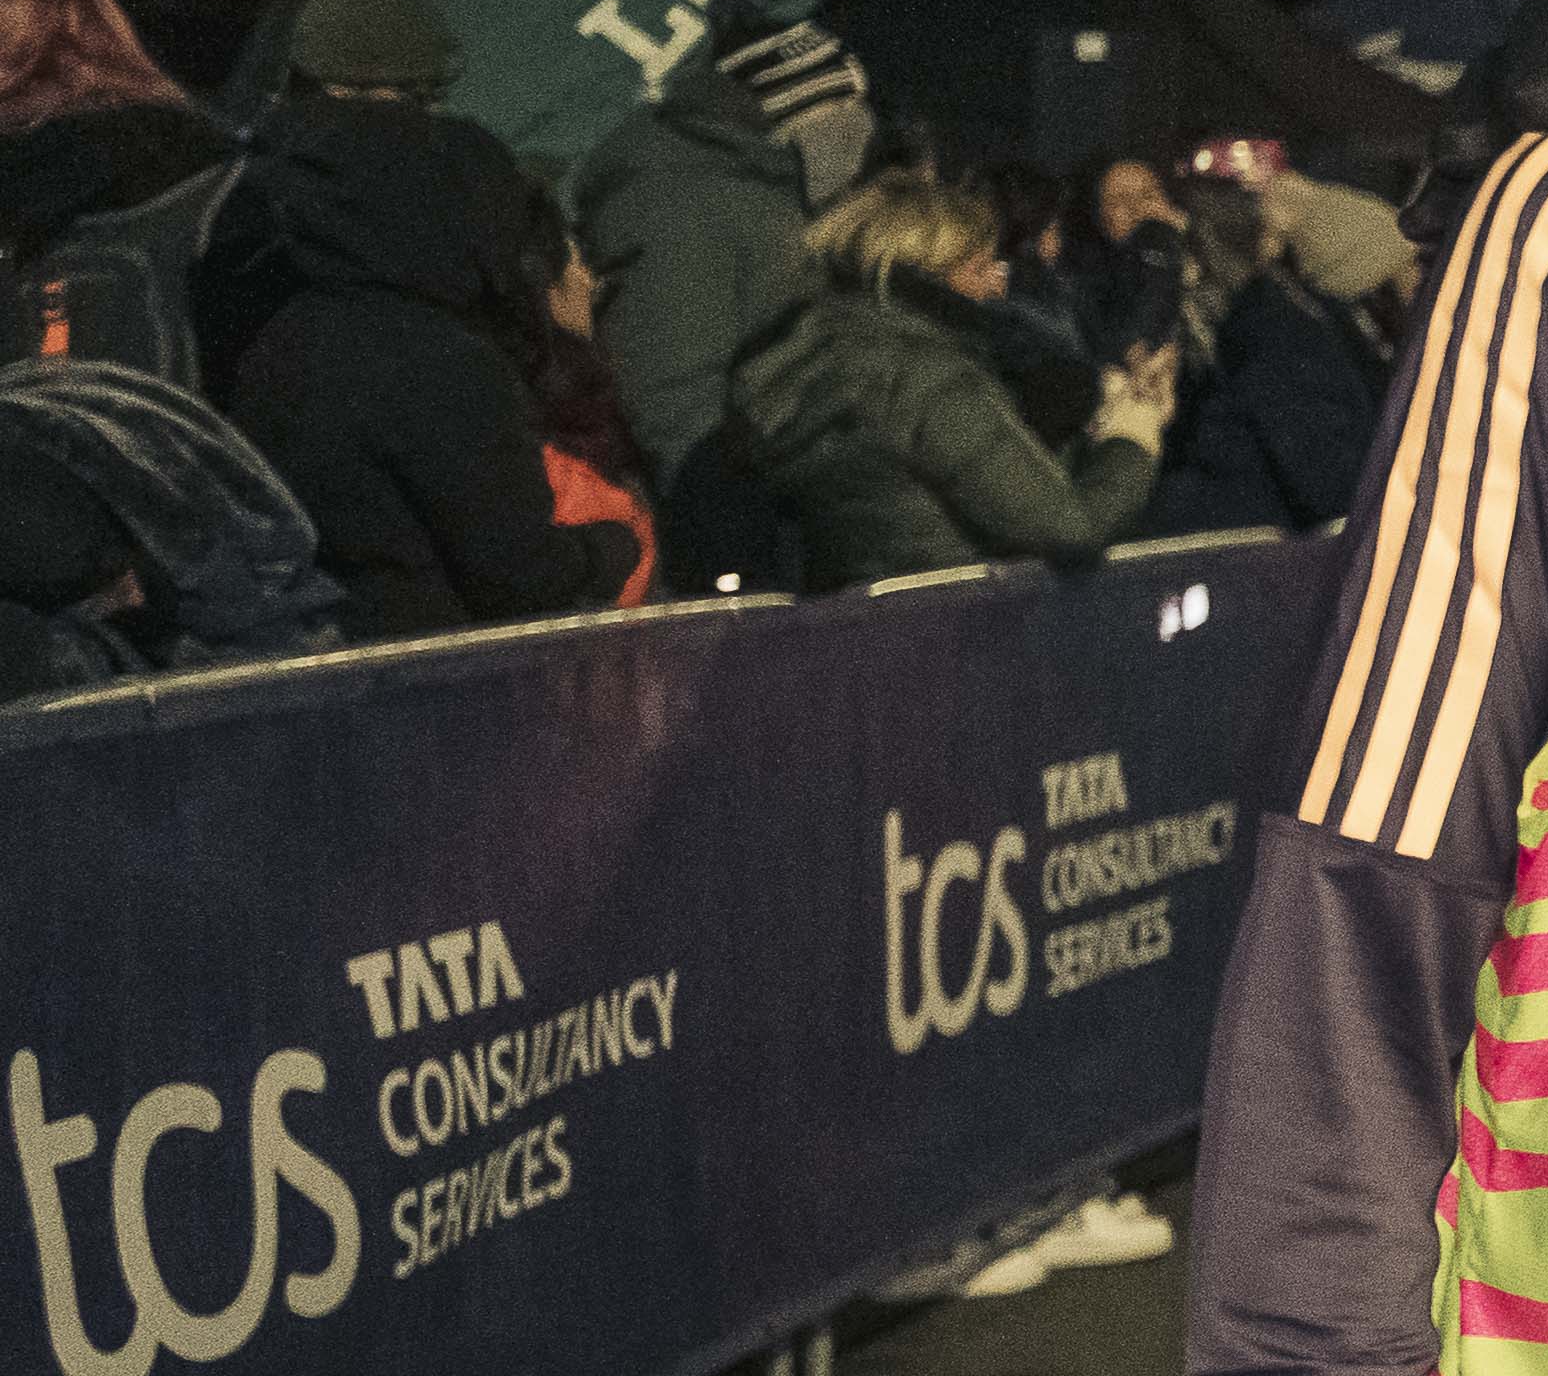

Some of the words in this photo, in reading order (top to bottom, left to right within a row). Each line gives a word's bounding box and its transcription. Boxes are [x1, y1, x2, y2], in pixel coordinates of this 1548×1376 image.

[1042, 753, 1127, 827] TATA
[1042, 801, 1236, 913] CONSULTANCY
[347, 921, 523, 1039] TATA
[882, 810, 1028, 1054] tcs
[1045, 899, 1171, 997] SERVICES
[378, 971, 677, 1157] CONSULTANCY
[392, 1119, 572, 1279] SERVICES
